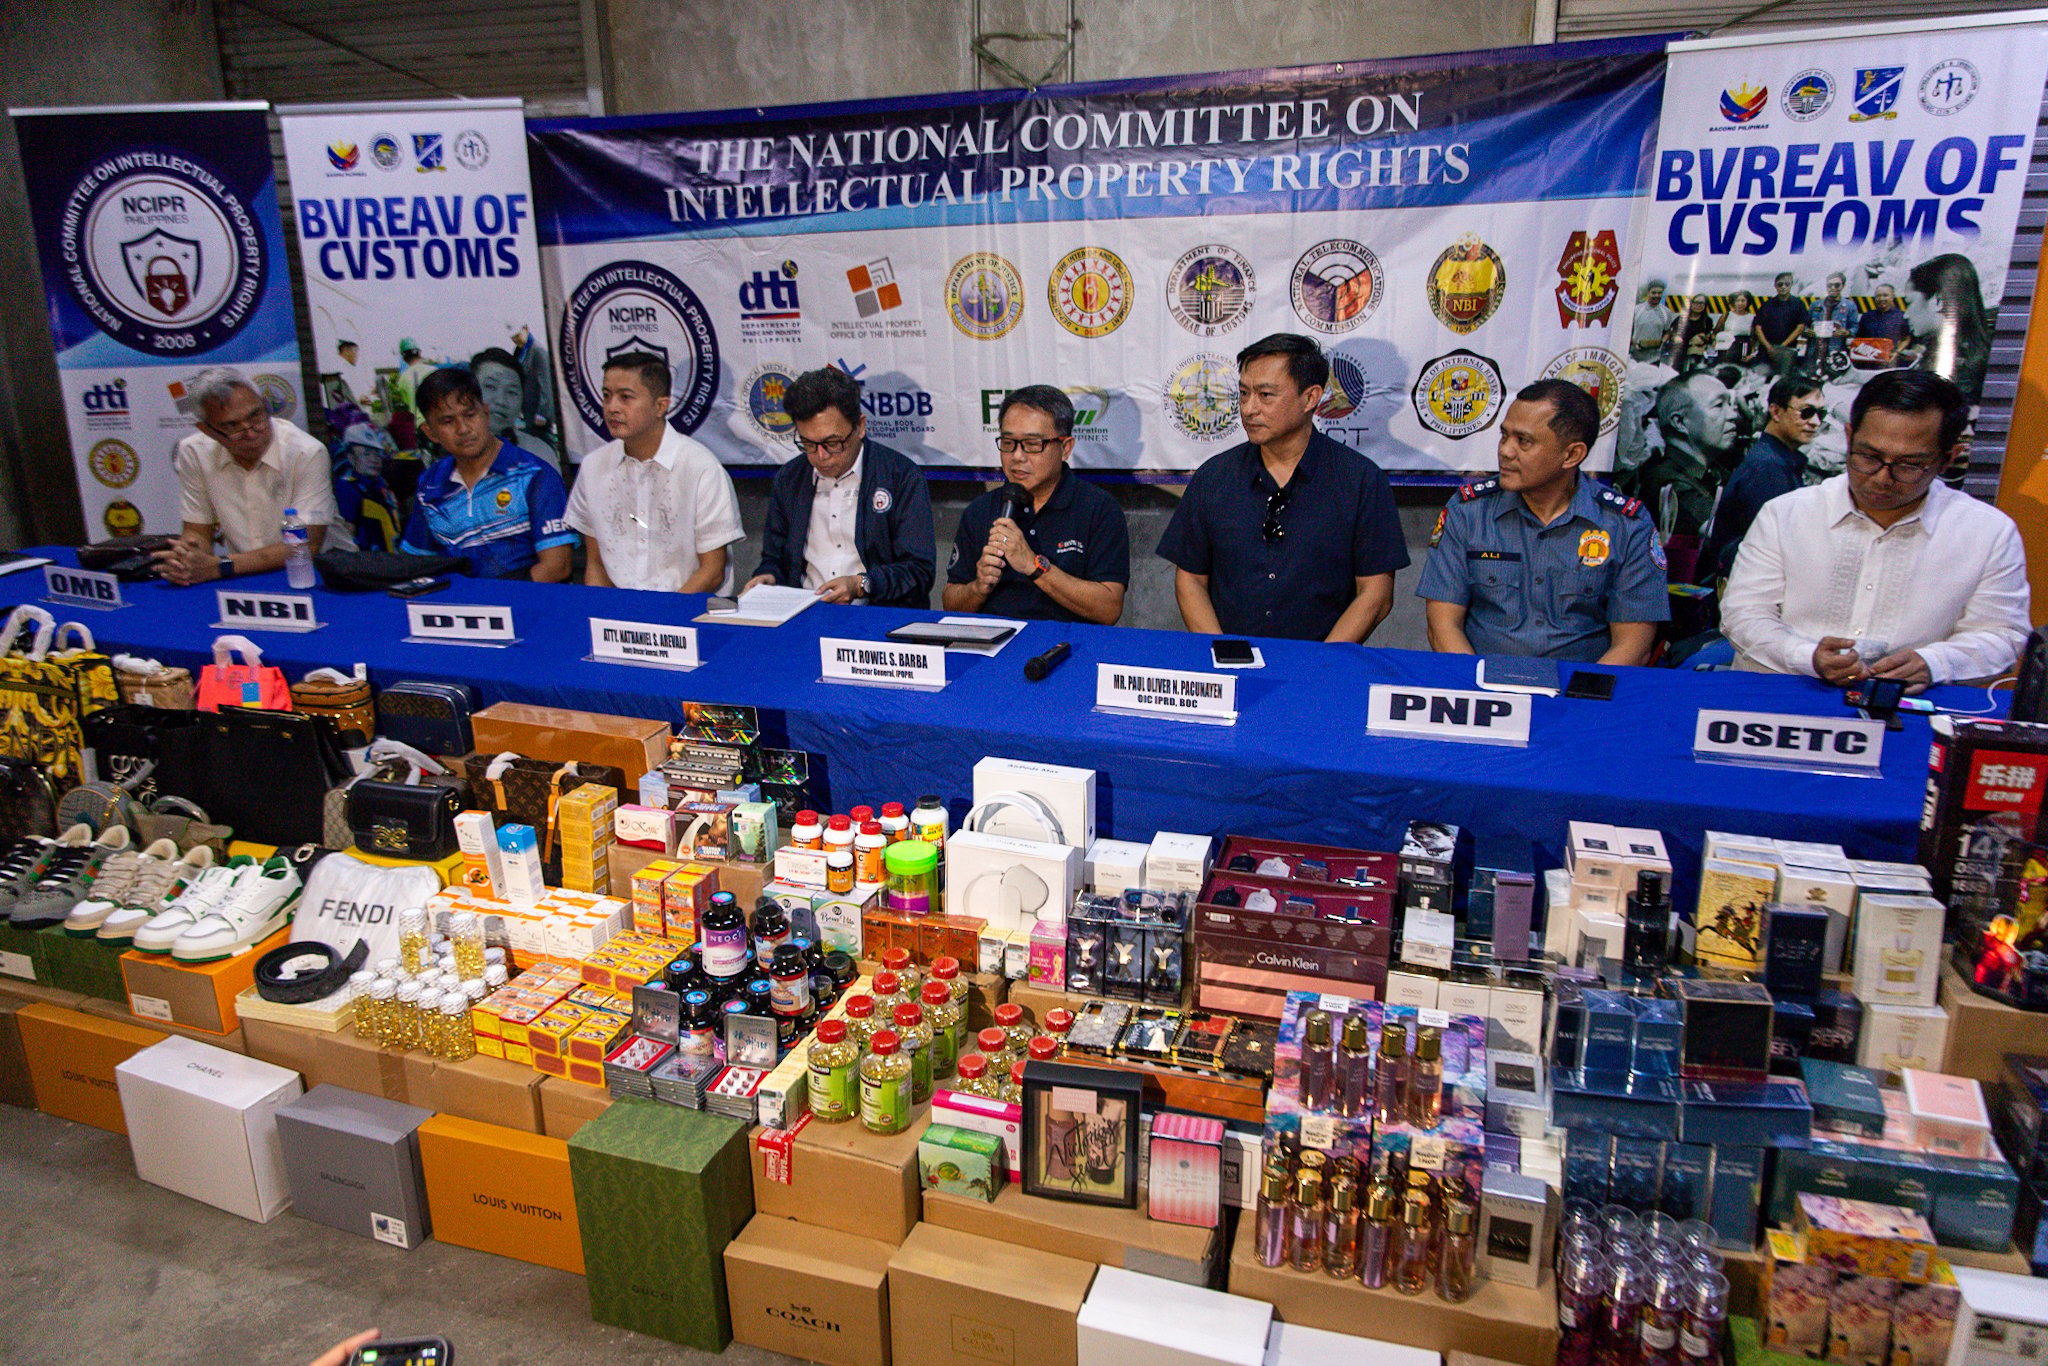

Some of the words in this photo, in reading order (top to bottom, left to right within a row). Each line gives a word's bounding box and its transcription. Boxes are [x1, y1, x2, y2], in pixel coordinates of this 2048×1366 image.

[695, 137, 776, 175] THE
[788, 117, 1009, 170] NATIONAL
[1020, 97, 1331, 153] COMMITTEE
[1345, 92, 1425, 136] ON
[95, 160, 120, 181] ON
[116, 151, 226, 198] INTELLECTUAL
[1655, 138, 1917, 202] BVREAV
[1923, 133, 2027, 197] OF
[664, 168, 988, 223] INTELLECTUAL
[1001, 157, 1257, 203] PROPERTY
[1269, 142, 1471, 192] RIGHTS
[121, 195, 187, 214] NCIPR
[61, 174, 99, 262] COMMITTEE
[125, 214, 190, 225] PHILIPPINES
[298, 195, 464, 239] BVREAV
[474, 193, 528, 236] OF
[1667, 197, 1986, 257] CVSTOMS
[223, 192, 260, 277] PROPERTY
[319, 237, 521, 281] CVSTOMS
[1168, 246, 1210, 294] DEPARTMENT
[1217, 247, 1230, 255] OF
[1233, 254, 1256, 293] FINANCE
[588, 275, 609, 295] ON
[604, 267, 689, 310] INTELLECTUAL
[738, 259, 801, 312] dti
[951, 258, 986, 299] DEPARTMENT
[988, 259, 998, 268] OF
[65, 264, 123, 332] NATIONAL
[221, 275, 259, 328] RIGHTS
[1452, 298, 1478, 312] NBI
[608, 306, 658, 323] NCIPR
[831, 321, 883, 330] INTELLECTUAL
[885, 320, 923, 329] PROPERTY
[1171, 305, 1201, 334] BUREAU
[1205, 326, 1217, 337] OF
[1221, 300, 1253, 334] CUSTOMS
[610, 324, 660, 334] PHILIPPINES
[830, 330, 856, 340] OFFICE
[857, 330, 868, 339] OF
[870, 330, 884, 339] THE
[885, 329, 928, 339] PHILIPPINES
[153, 334, 197, 349] 2008
[685, 304, 715, 384] PROPERTY
[1429, 363, 1440, 375] OF
[1440, 356, 1485, 371] INTERNAL
[1564, 354, 1578, 364] OF
[83, 377, 129, 410] dti
[681, 378, 713, 428] RIGHTS
[1429, 418, 1483, 436] PHILIPPINES
[1480, 551, 1501, 560] ALI
[51, 573, 115, 601] OMB
[226, 599, 309, 621] NBI
[421, 614, 505, 630] DTI
[619, 629, 652, 646] NATHANIEL
[652, 632, 659, 647] S.
[660, 633, 687, 650] AREVALO
[836, 647, 857, 664] ATTY.
[858, 650, 888, 666] ROWEL
[889, 652, 898, 667] S.
[898, 653, 928, 669] BARBA
[851, 666, 873, 676] Director
[1113, 674, 1127, 690] MR.
[1128, 675, 1146, 692] PAUL
[1146, 677, 1171, 694] OLIVER
[1172, 679, 1180, 695] N.
[1179, 698, 1198, 708] BOC
[1388, 692, 1513, 727] PNP
[1707, 720, 1869, 755] OSETC
[318, 898, 394, 925] FENDI
[1256, 951, 1292, 968] Calvin
[1292, 956, 1319, 971] Klein
[186, 1060, 226, 1080] CHANEL
[813, 1075, 820, 1085] E
[88, 1075, 118, 1092] VUITTO
[864, 1087, 871, 1097] E
[473, 1192, 508, 1211] LOUIS
[510, 1201, 563, 1223] VUITTON
[631, 1284, 674, 1302] GUCCI
[765, 1306, 841, 1334] COACH
